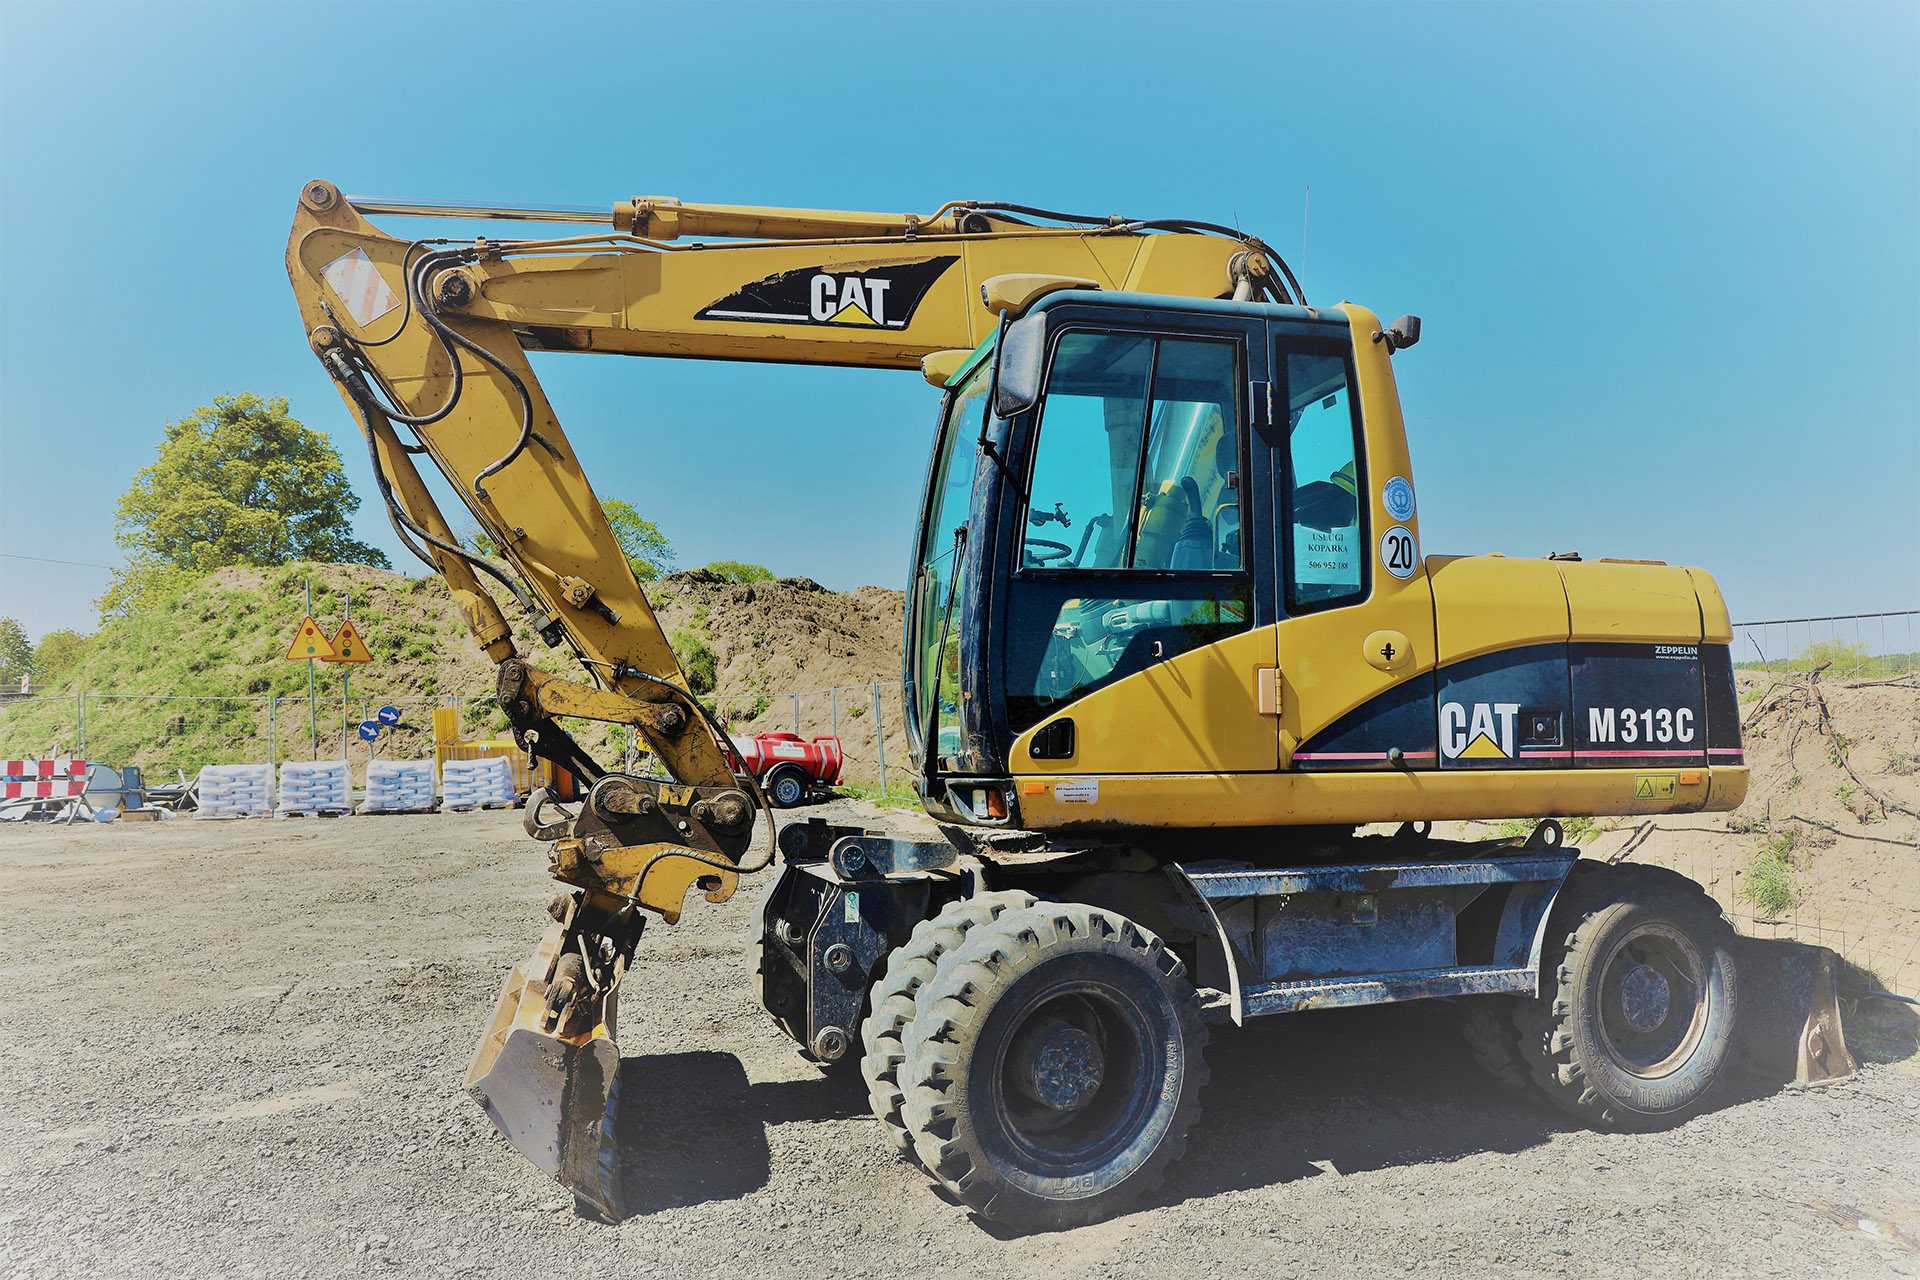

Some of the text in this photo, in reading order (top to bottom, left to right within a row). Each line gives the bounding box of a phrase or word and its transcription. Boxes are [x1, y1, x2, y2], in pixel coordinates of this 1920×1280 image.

[811, 274, 890, 325] CAT
[1308, 544, 1348, 553] KOPARKA
[1388, 535, 1412, 569] 20
[1323, 561, 1336, 569] 952
[1655, 645, 1698, 655] ZEPPELIN
[1440, 702, 1519, 758] CAT
